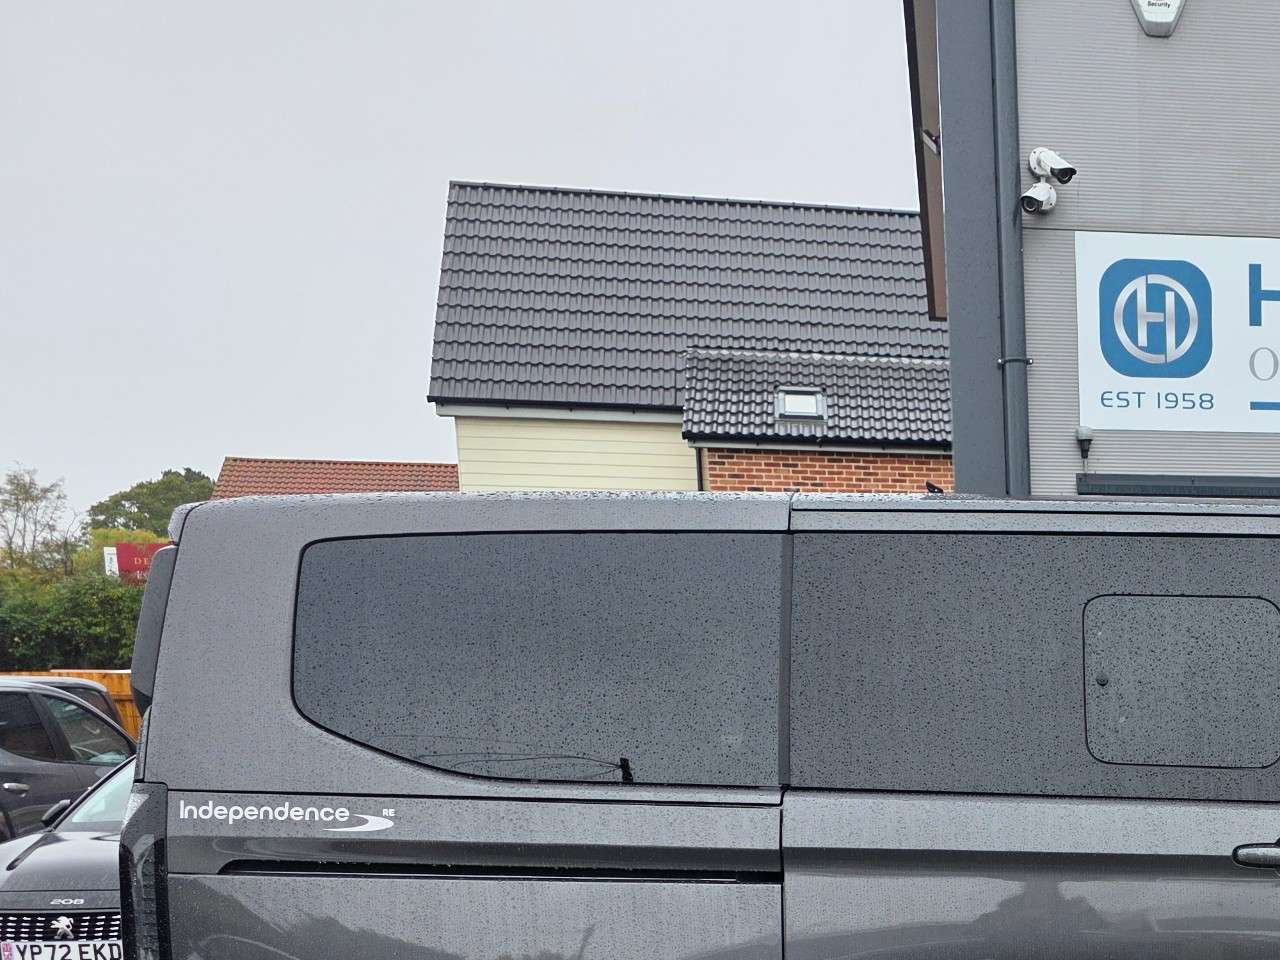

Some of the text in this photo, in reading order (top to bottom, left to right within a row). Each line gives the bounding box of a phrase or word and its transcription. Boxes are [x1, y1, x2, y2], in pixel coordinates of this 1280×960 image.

[1100, 390, 1214, 410] EST 1958
[179, 800, 350, 824] Independence
